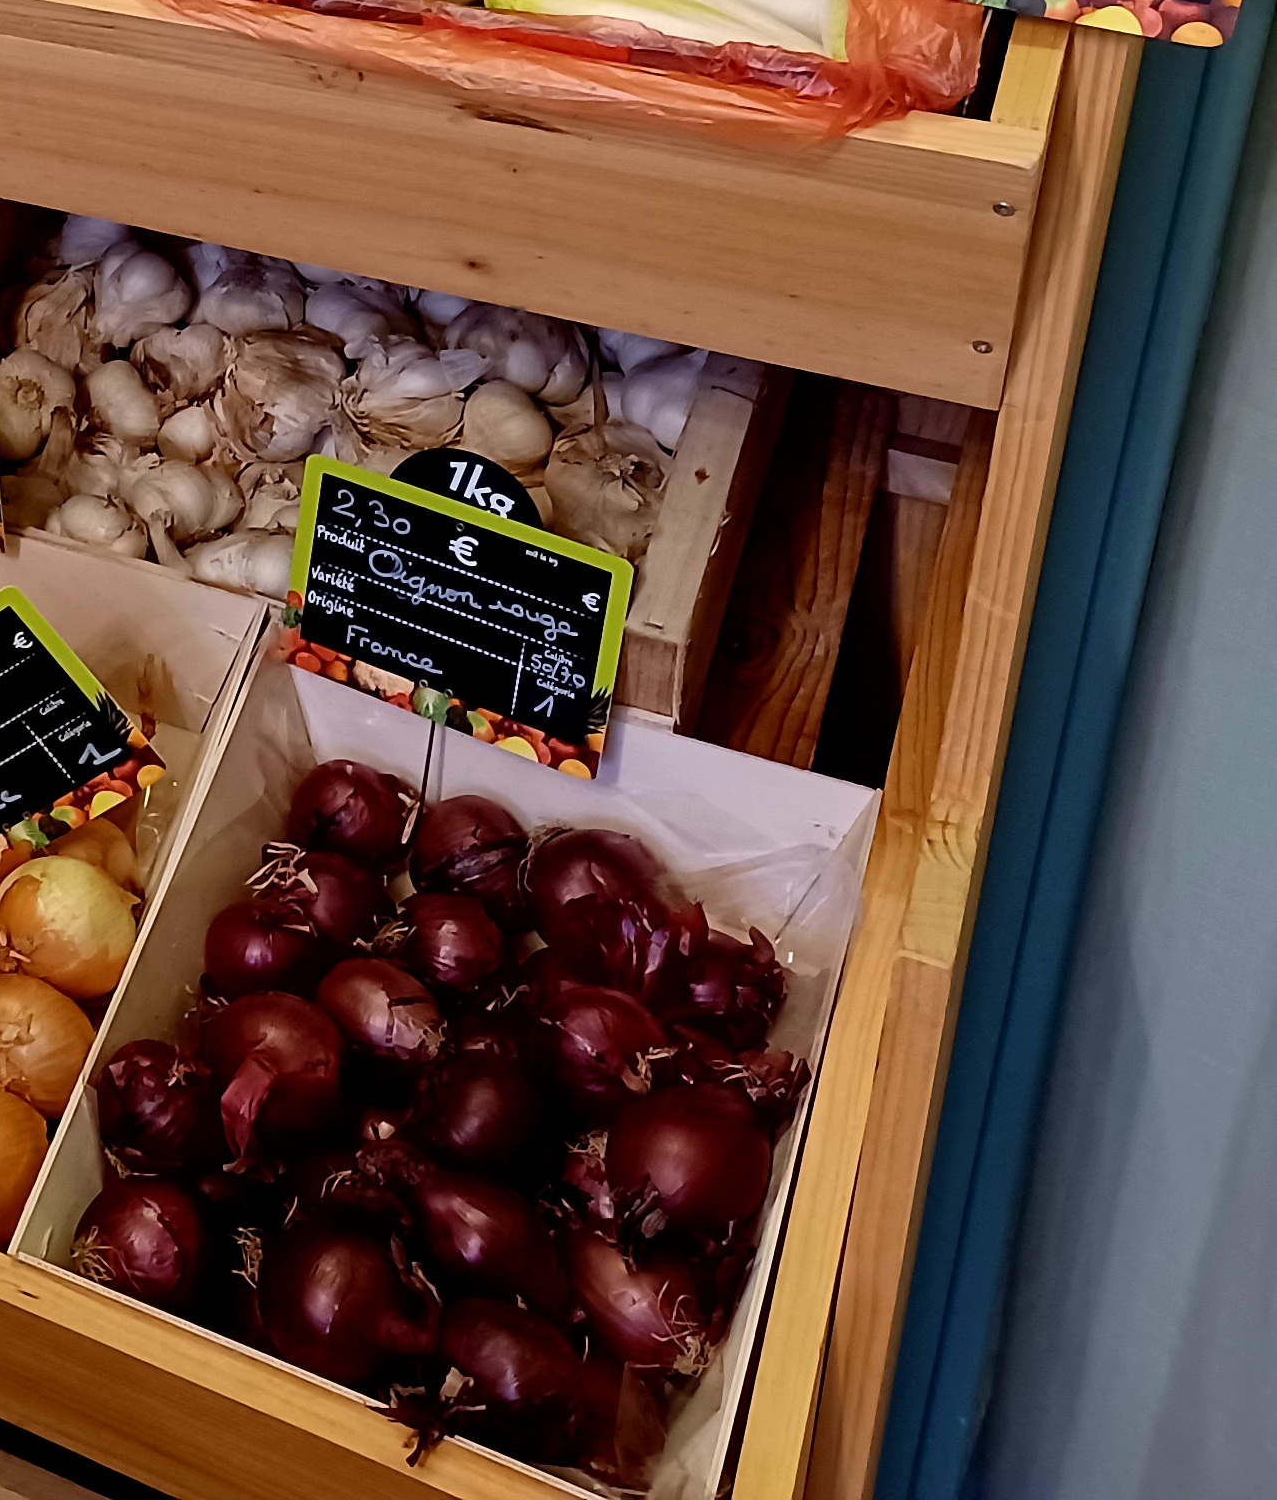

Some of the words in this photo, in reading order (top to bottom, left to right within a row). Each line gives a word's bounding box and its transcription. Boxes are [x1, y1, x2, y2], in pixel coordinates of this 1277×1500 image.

[449, 461, 516, 519] 1kg
[316, 524, 366, 554] Produit
[332, 489, 411, 535] 2,30
[448, 535, 479, 567] €
[307, 591, 354, 618] Origine
[311, 567, 355, 592] Variété
[368, 549, 482, 610] Oignon
[489, 601, 578, 641] rouge
[346, 625, 443, 675] France
